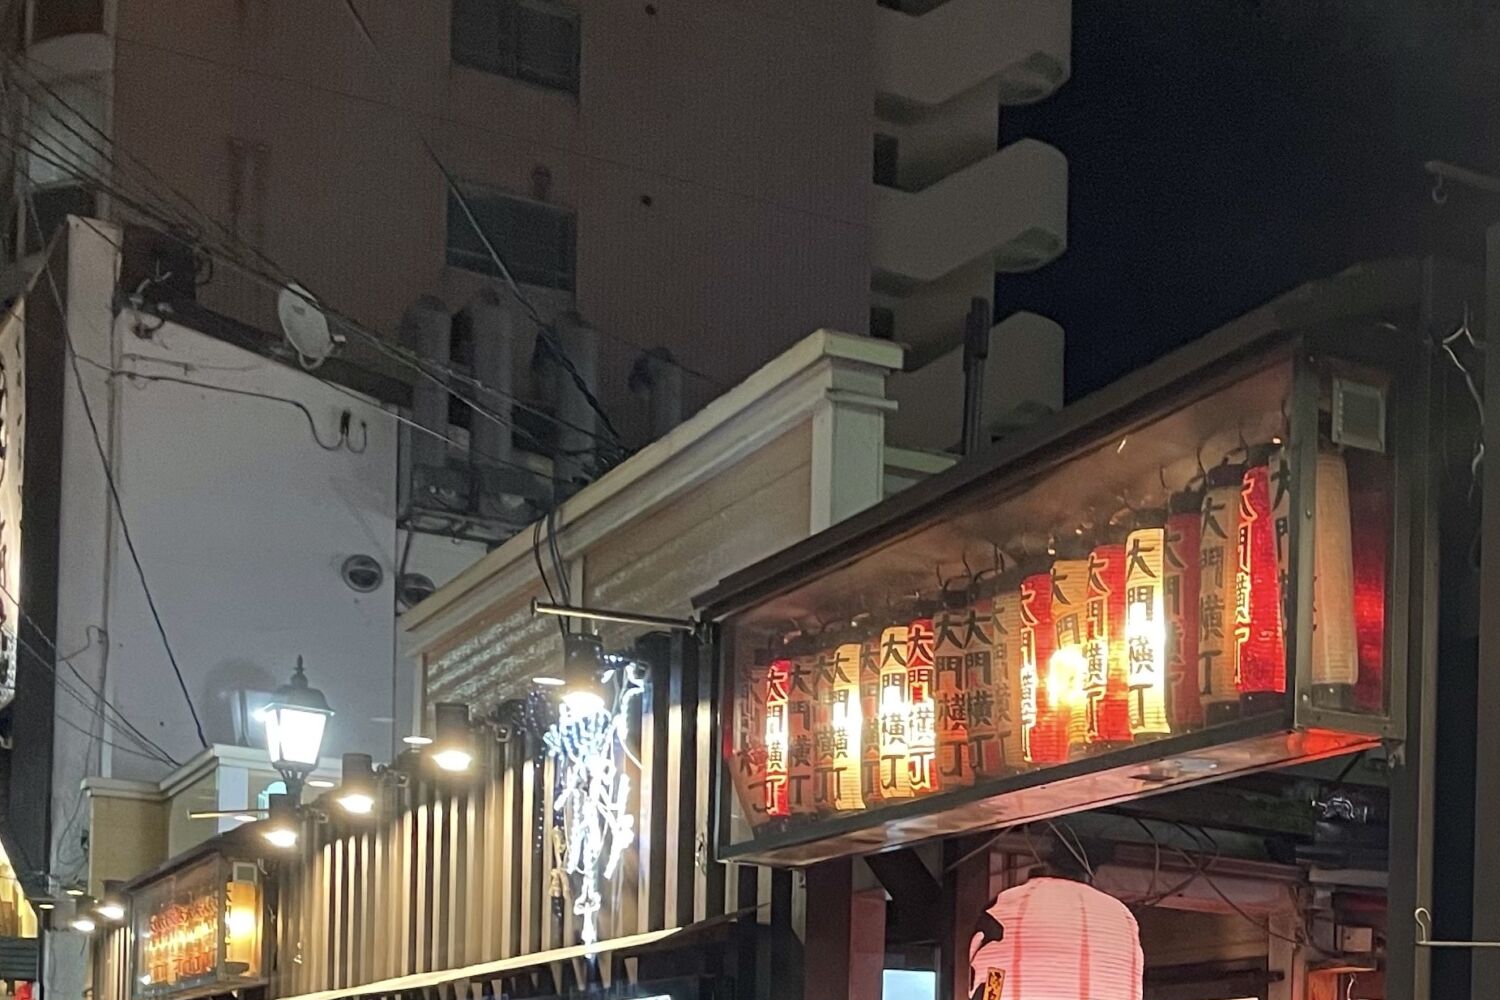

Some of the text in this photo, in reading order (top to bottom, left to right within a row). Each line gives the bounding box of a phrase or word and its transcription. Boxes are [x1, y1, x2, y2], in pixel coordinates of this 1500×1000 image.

[1126, 538, 1157, 729] 大門横丁
[1199, 497, 1229, 696] 大門横丁
[880, 632, 908, 790] 大門横丁
[908, 624, 935, 790] 大門横丁
